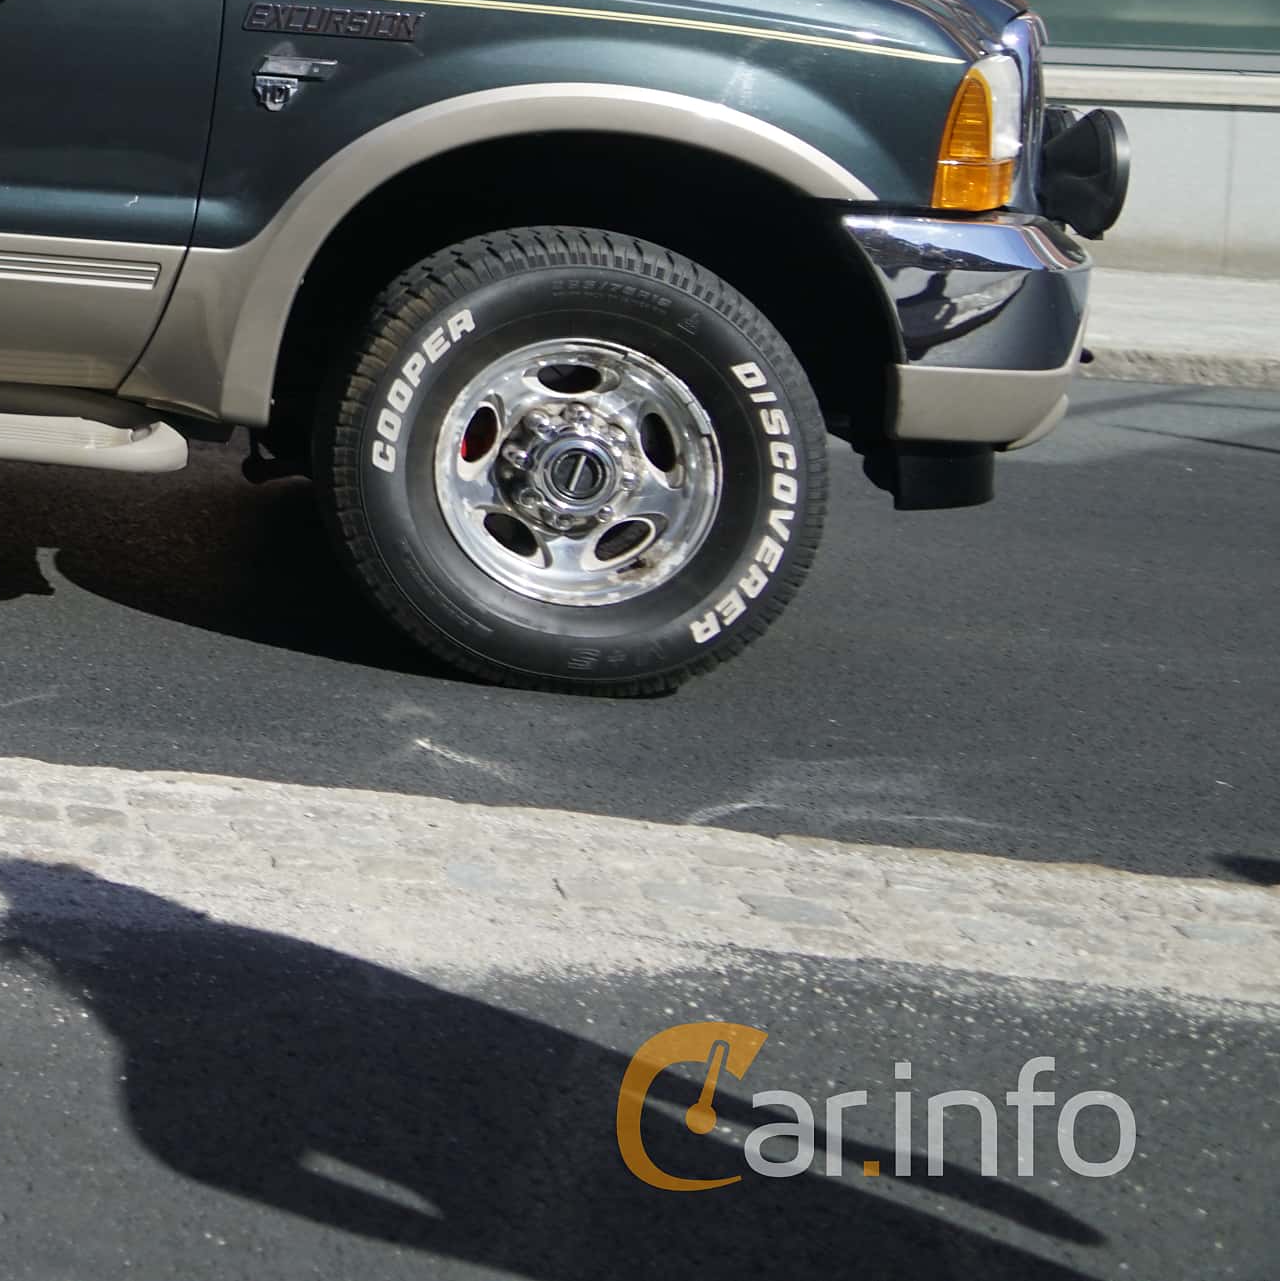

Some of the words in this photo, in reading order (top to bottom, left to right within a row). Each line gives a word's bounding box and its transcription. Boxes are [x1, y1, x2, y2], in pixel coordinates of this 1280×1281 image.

[248, 2, 426, 40] EXCURSION
[372, 309, 476, 473] COOPER
[690, 361, 798, 644] DISCOVERER
